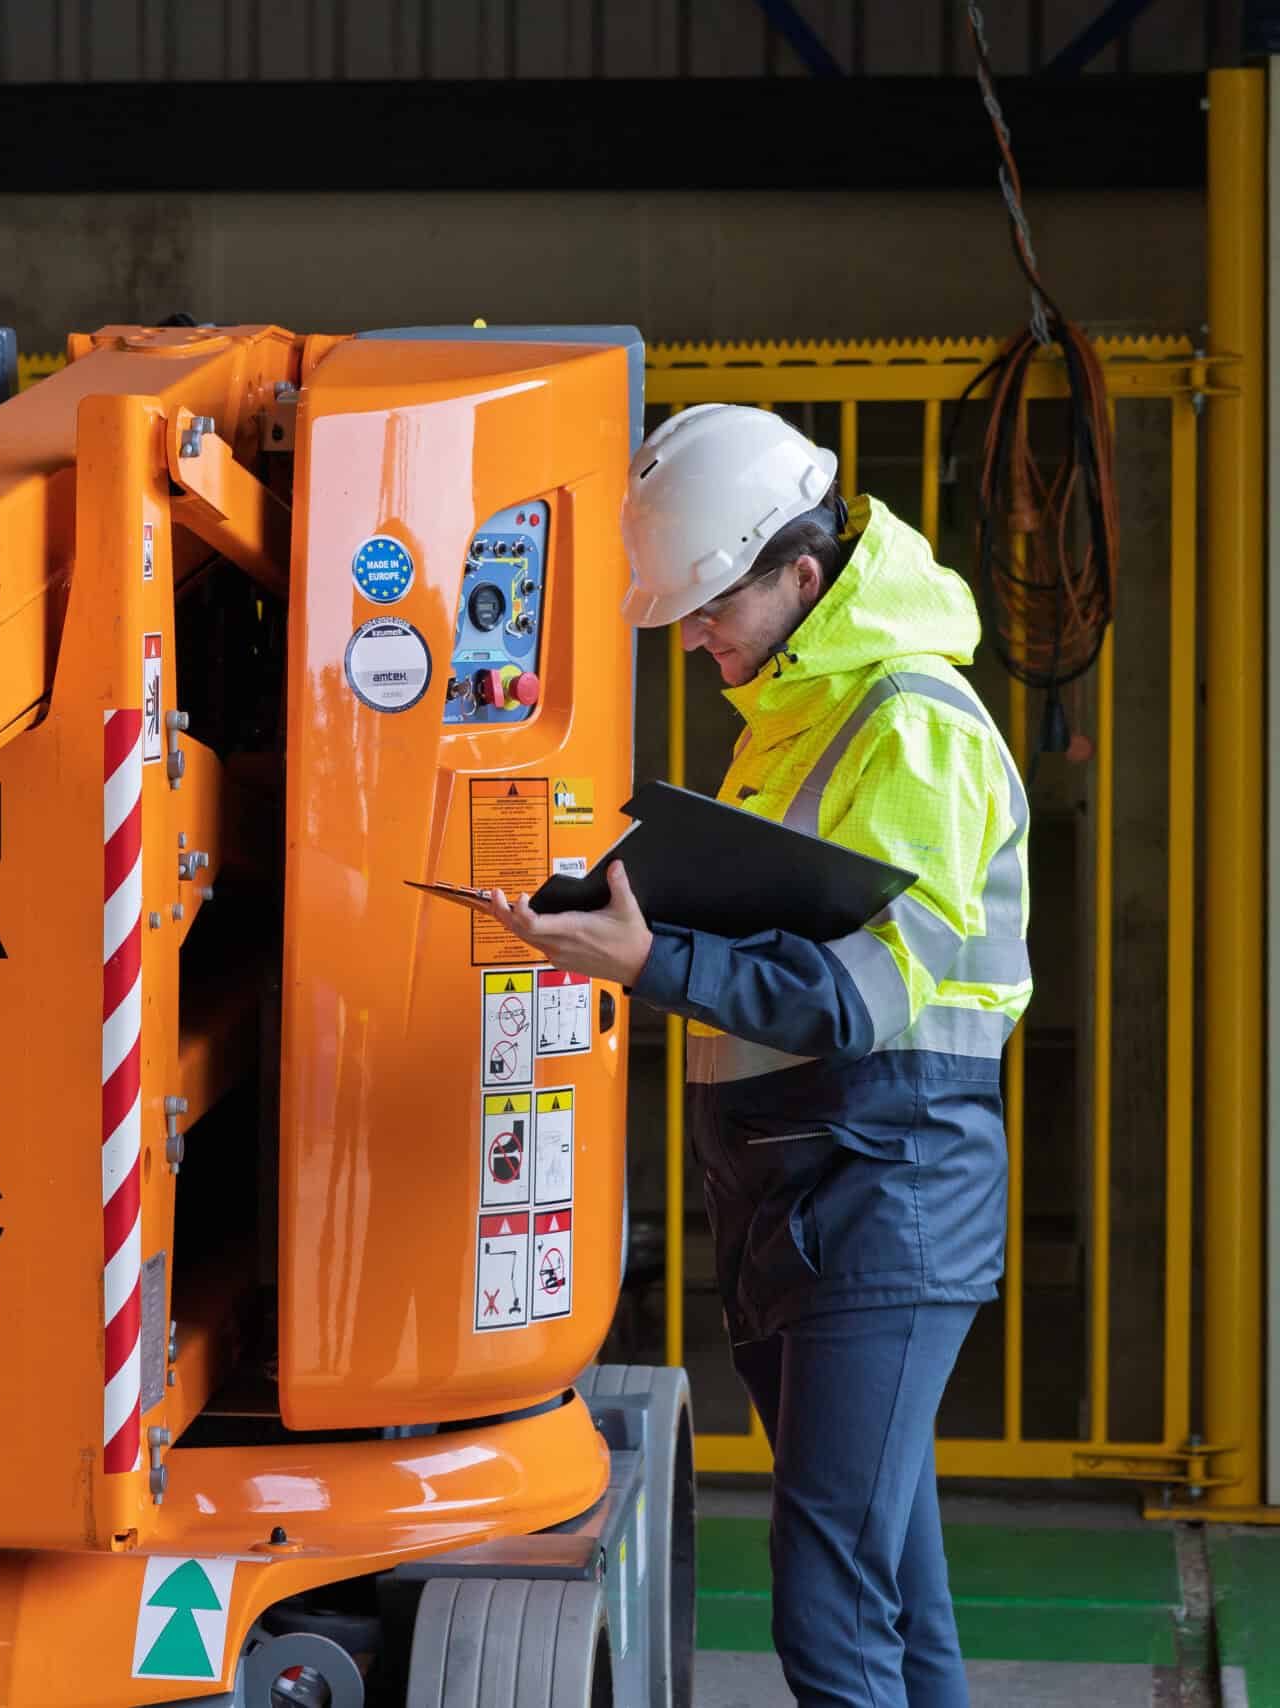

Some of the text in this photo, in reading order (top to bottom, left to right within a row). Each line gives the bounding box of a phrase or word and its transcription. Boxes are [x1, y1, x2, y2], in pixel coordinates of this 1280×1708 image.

[366, 560, 399, 569] MADE IN
[368, 572, 400, 581] EUROPE
